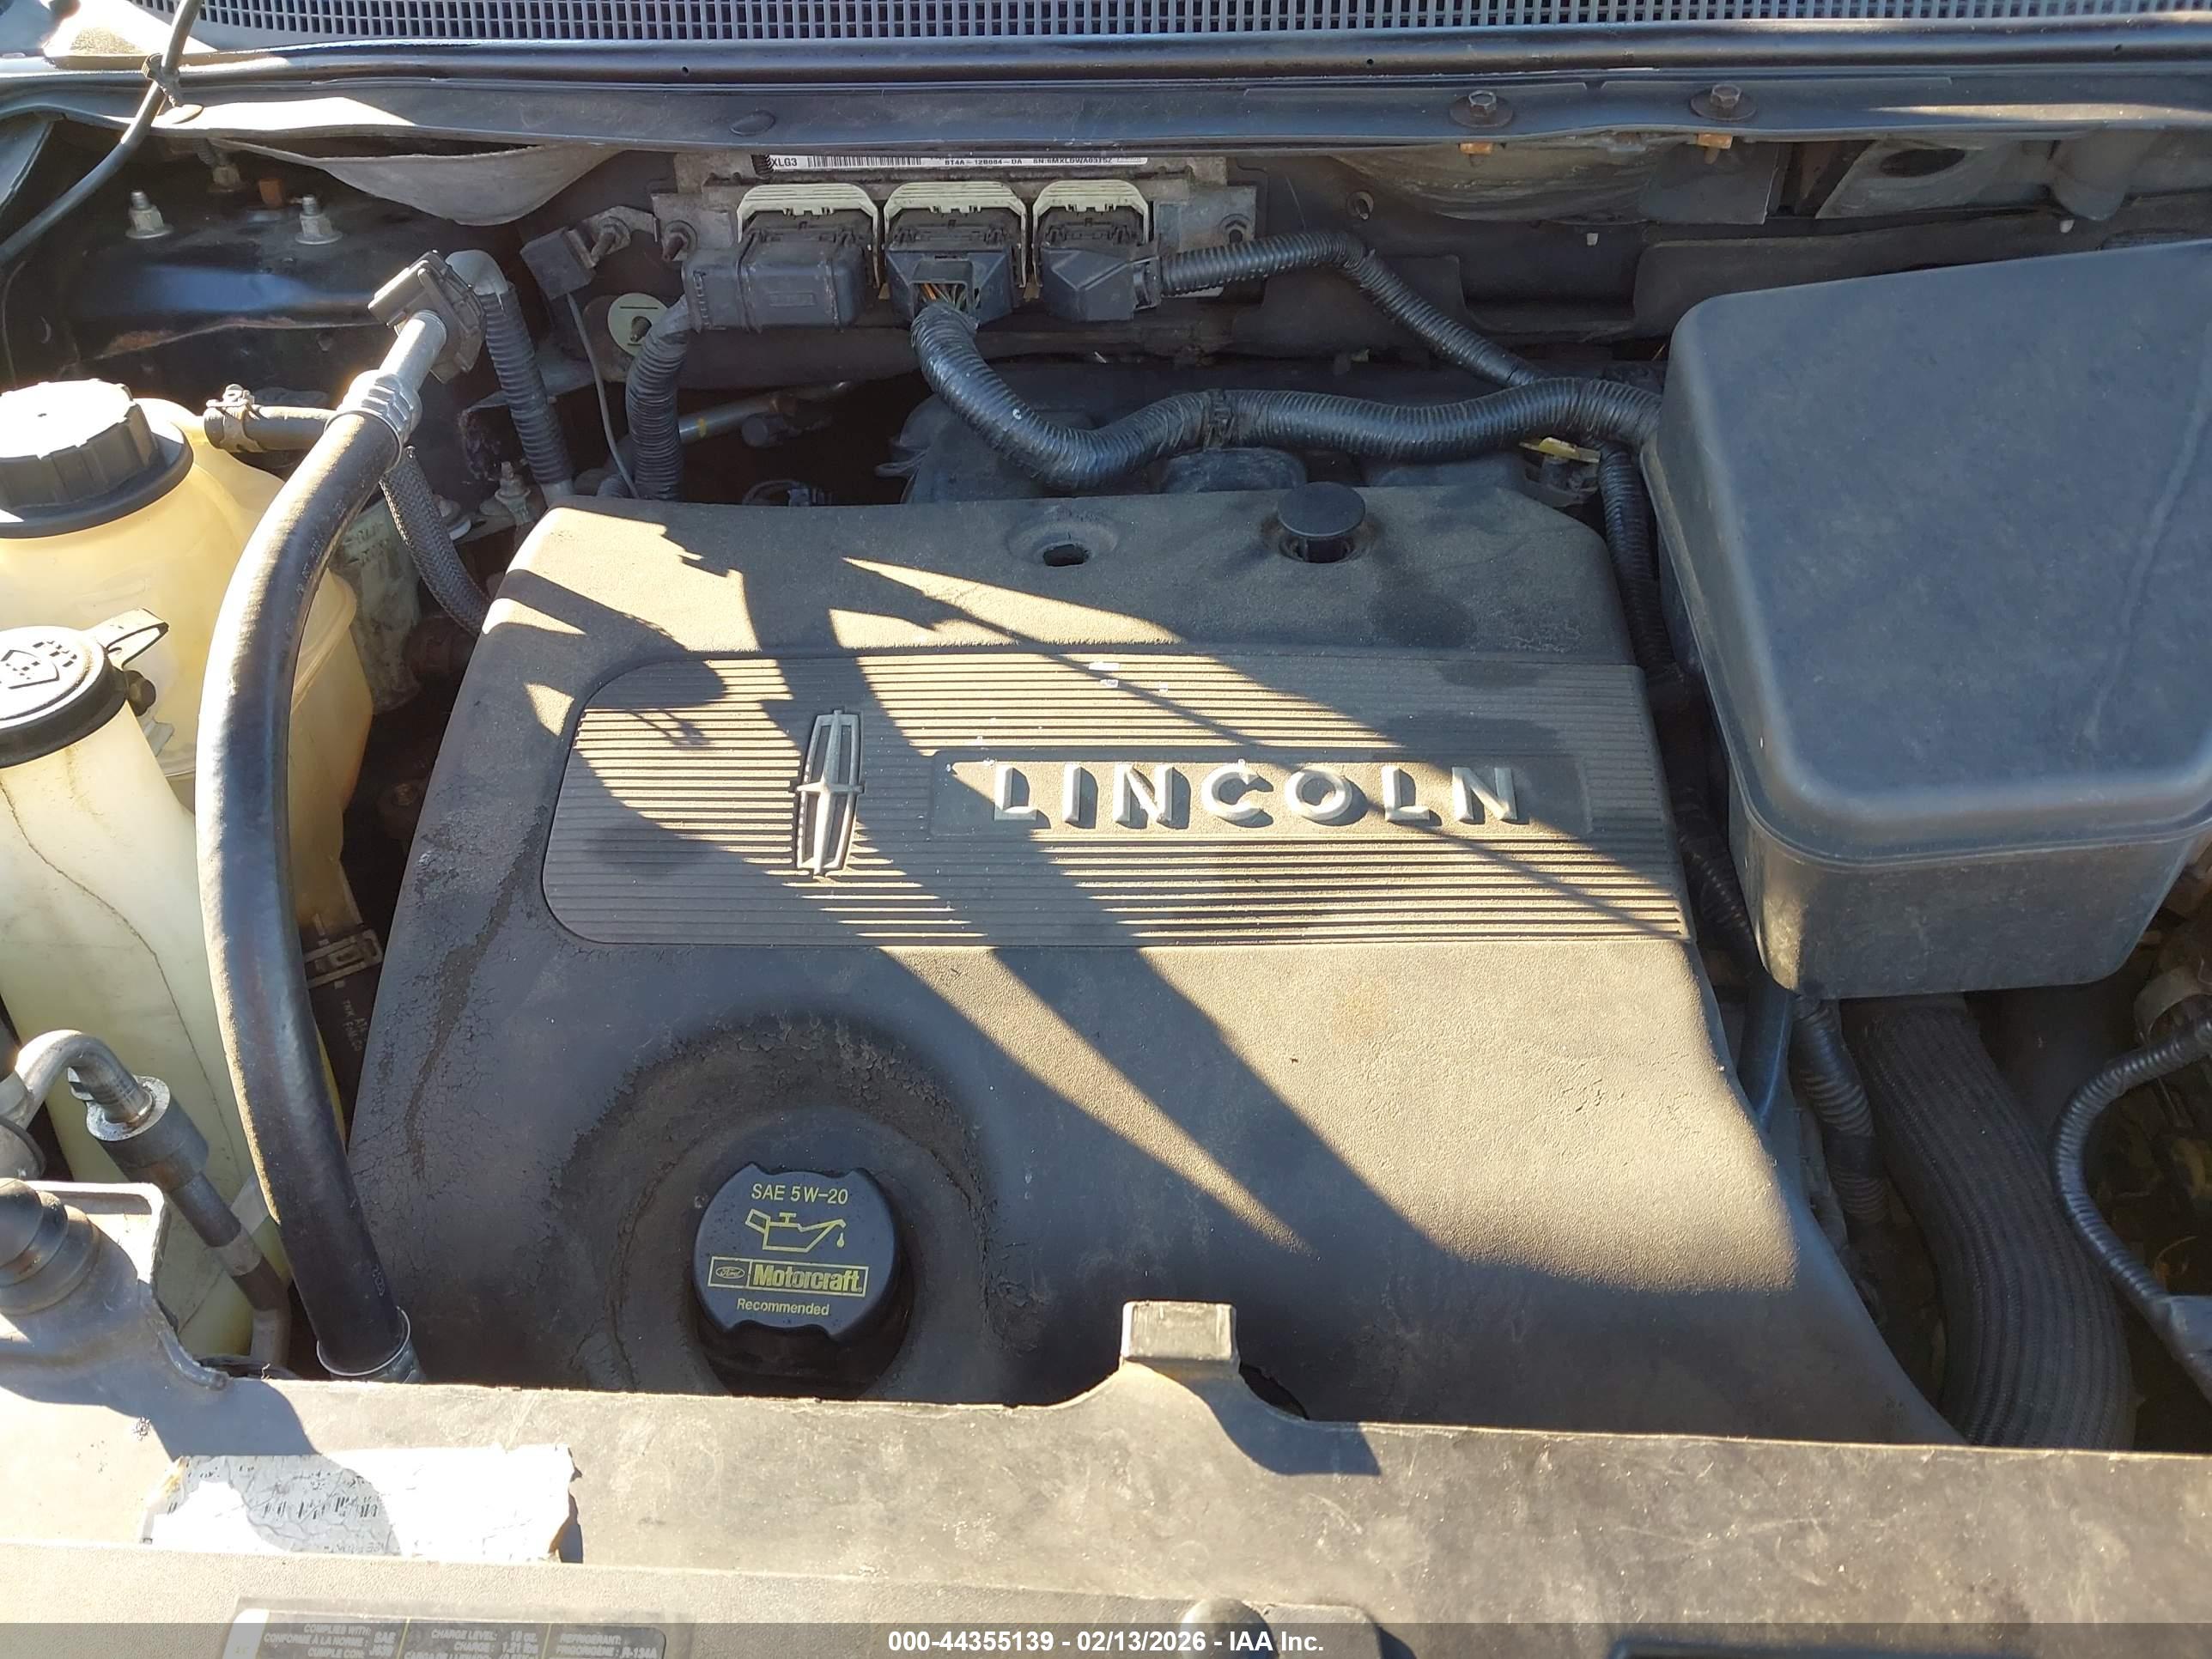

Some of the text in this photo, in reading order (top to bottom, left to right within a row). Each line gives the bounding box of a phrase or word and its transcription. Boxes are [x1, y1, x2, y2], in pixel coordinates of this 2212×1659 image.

[770, 157, 798, 167] XLG3
[994, 763, 1519, 823] LINCOLN
[751, 1183, 848, 1205] SAE 5W-20
[752, 1263, 860, 1292] Motorcraft
[737, 1297, 830, 1316] Recommended
[303, 1623, 372, 1636] COMPLIES WITH:
[431, 1629, 468, 1640] CHARGE
[264, 1632, 312, 1644] CONFORME
[320, 1636, 331, 1645] LA
[374, 1632, 397, 1644] SAE
[307, 1647, 343, 1658] CUMPLE
